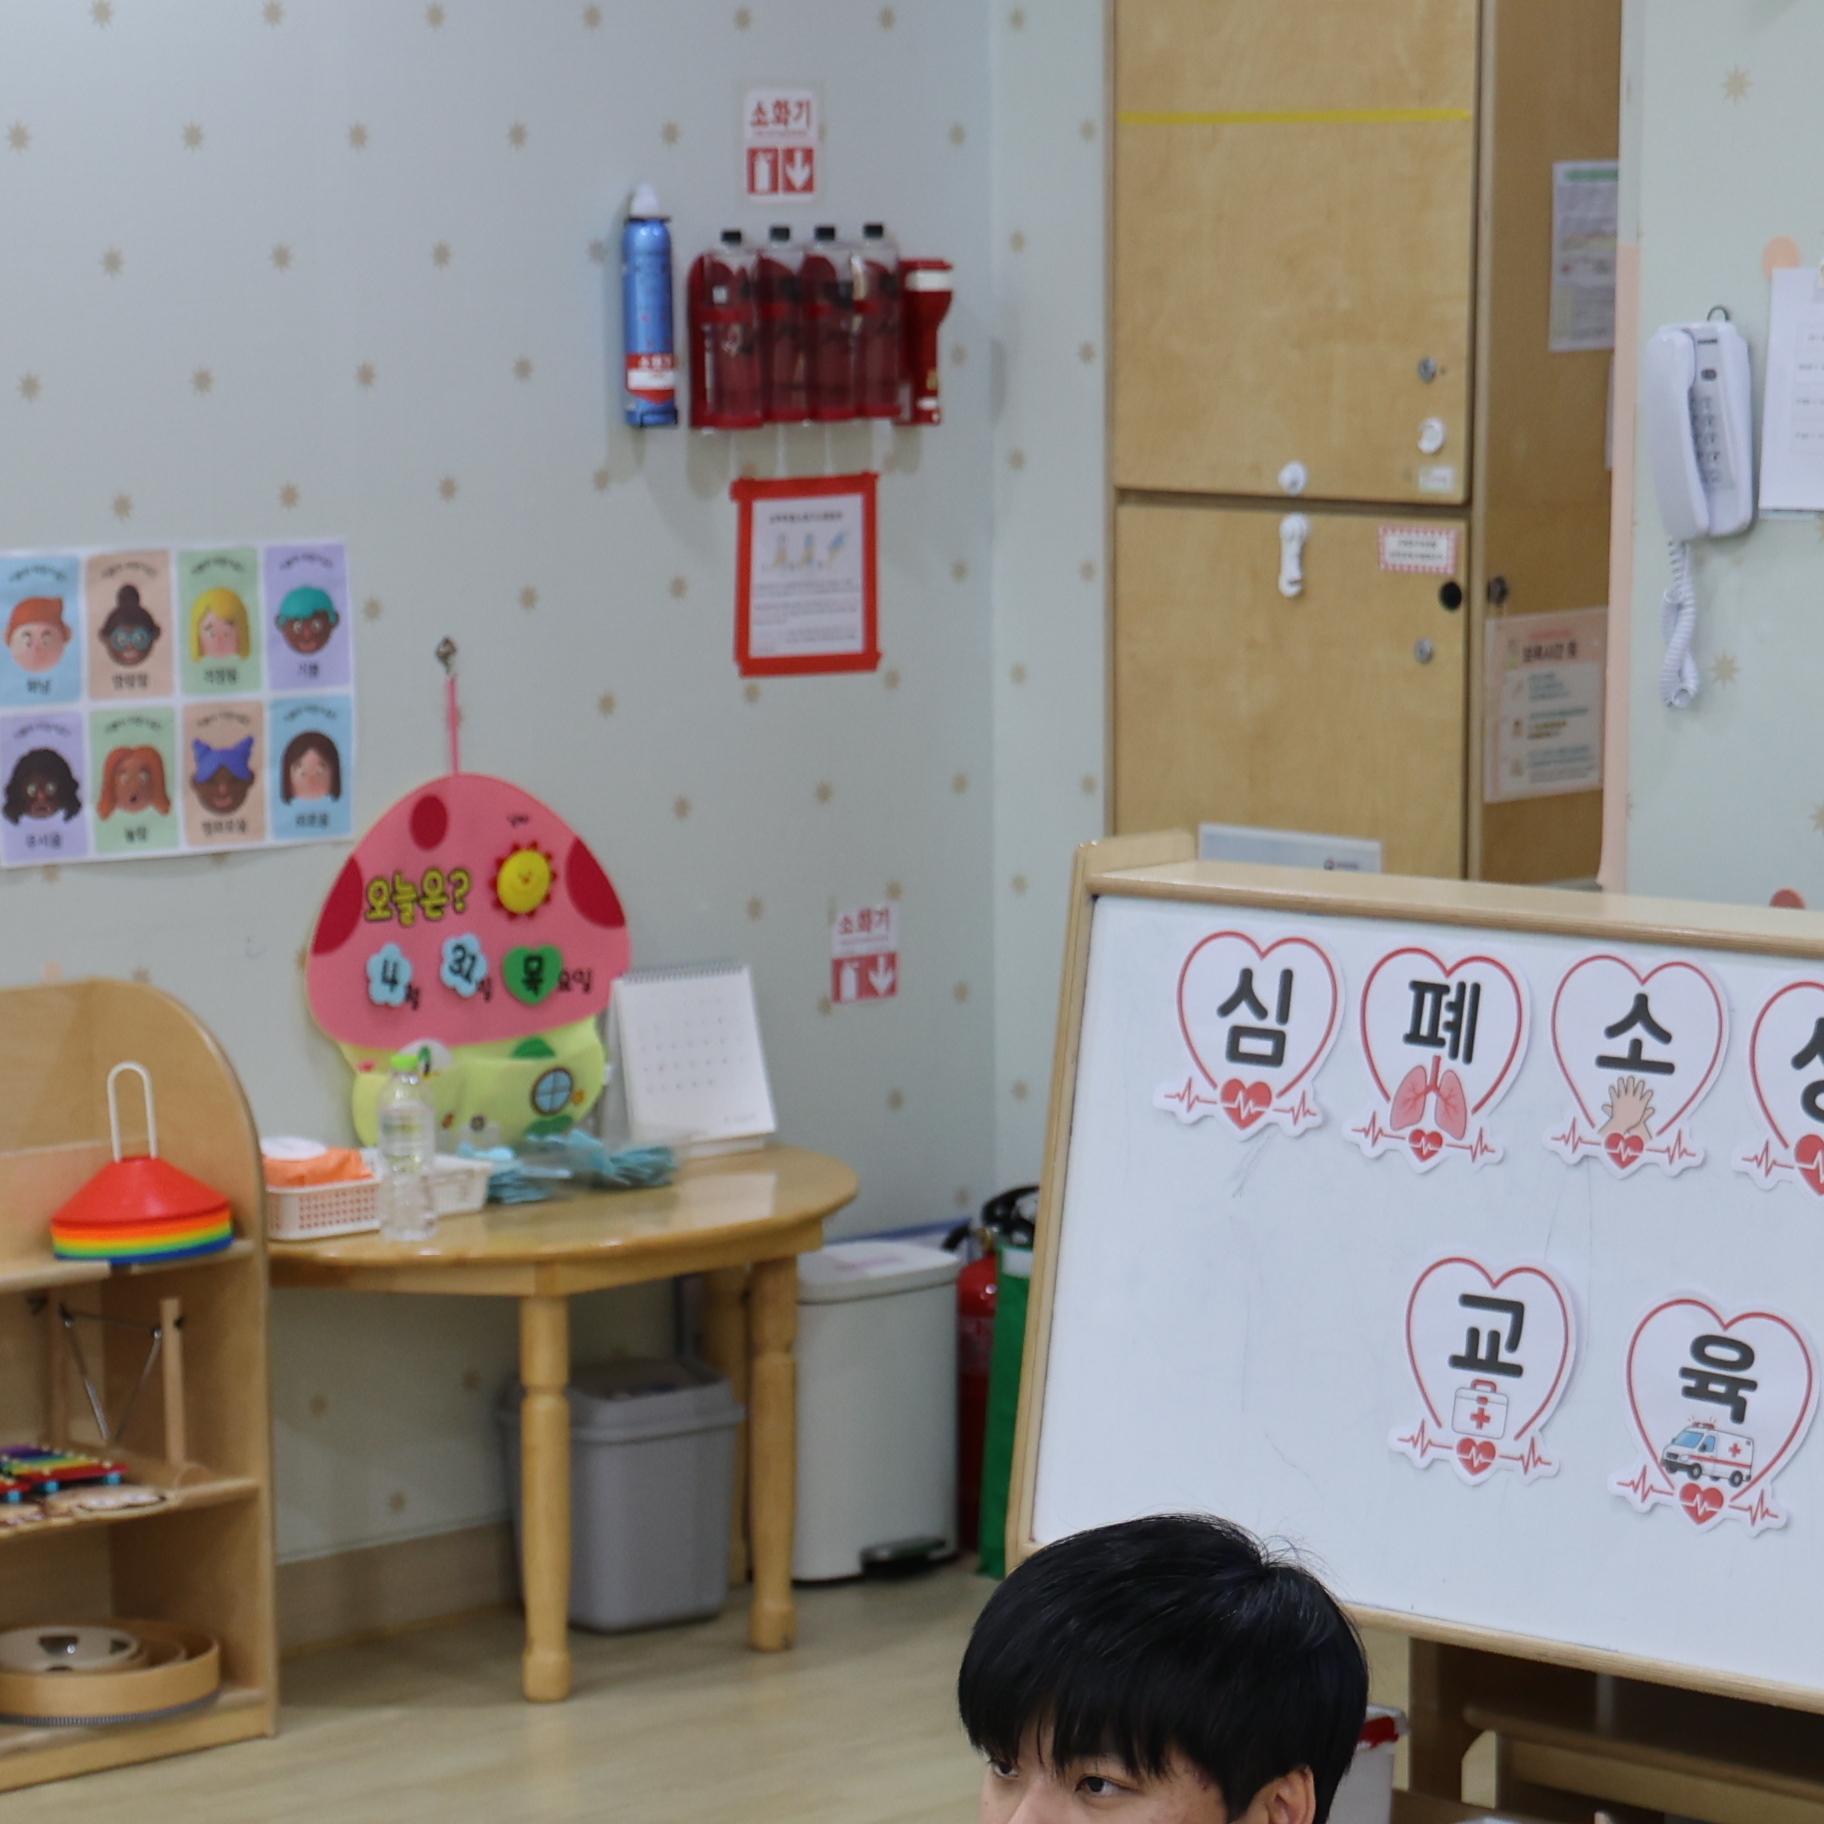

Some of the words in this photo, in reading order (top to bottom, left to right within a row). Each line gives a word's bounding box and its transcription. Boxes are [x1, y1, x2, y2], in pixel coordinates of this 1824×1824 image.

[750, 99, 812, 128] 소화기
[364, 867, 471, 927] 오늘은?
[1216, 966, 1295, 1069] 심
[1404, 978, 1480, 1066] 폐
[1596, 992, 1676, 1077] 소
[1448, 1292, 1526, 1379] 교
[1679, 1334, 1758, 1426] 육
